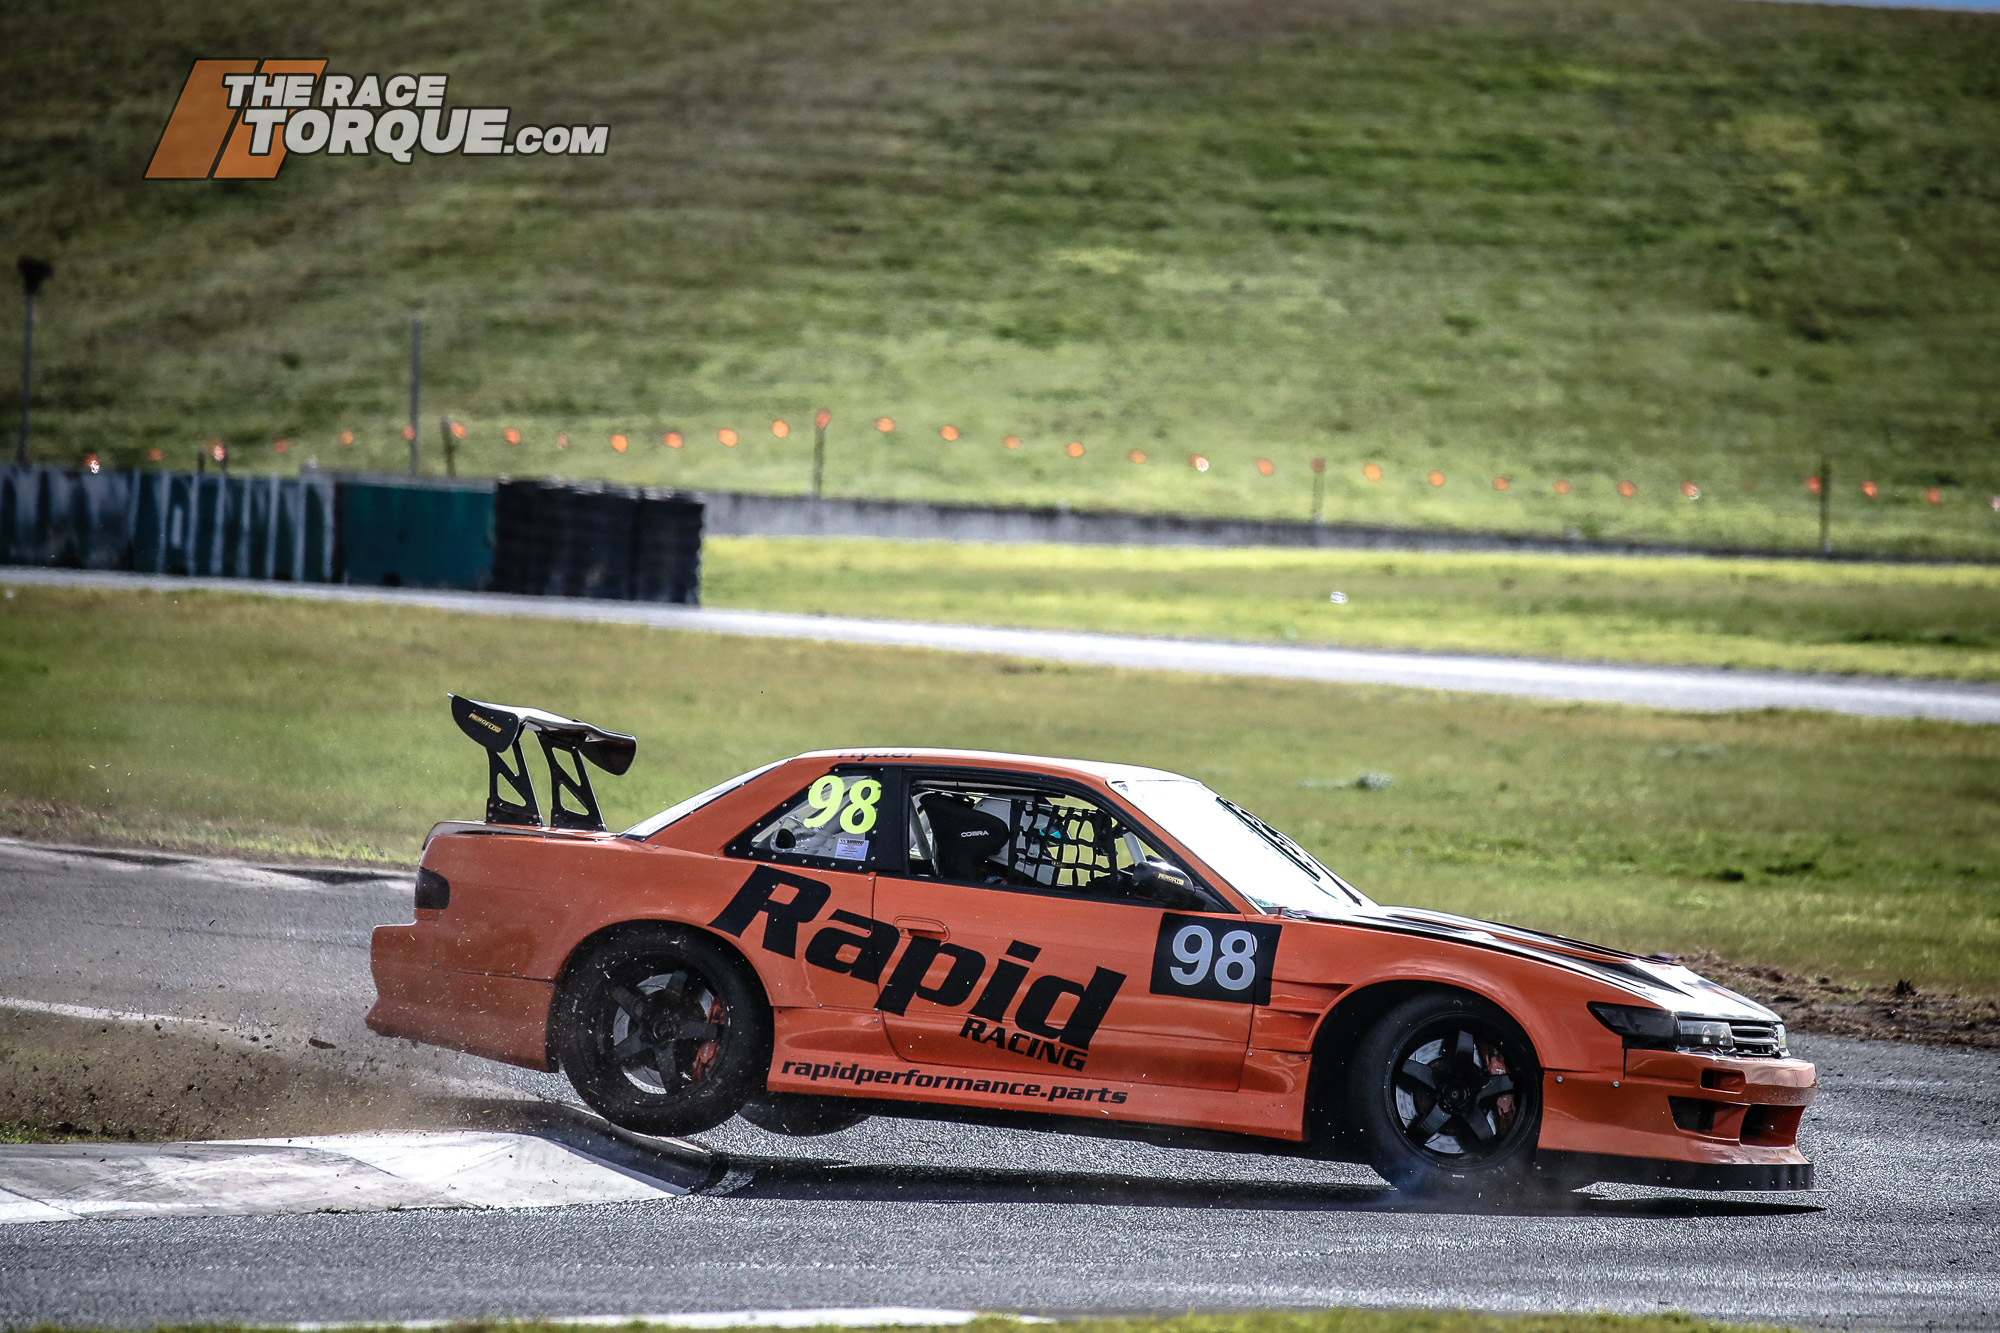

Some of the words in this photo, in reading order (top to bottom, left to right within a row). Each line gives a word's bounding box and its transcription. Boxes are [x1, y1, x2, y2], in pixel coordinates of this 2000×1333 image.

[803, 775, 882, 834] 98
[960, 830, 989, 838] COBRA
[708, 864, 1127, 1050] Rapid
[1169, 925, 1259, 991] 98
[958, 1018, 1087, 1072] RACING
[780, 1060, 1128, 1105] rapidperformance.parts
